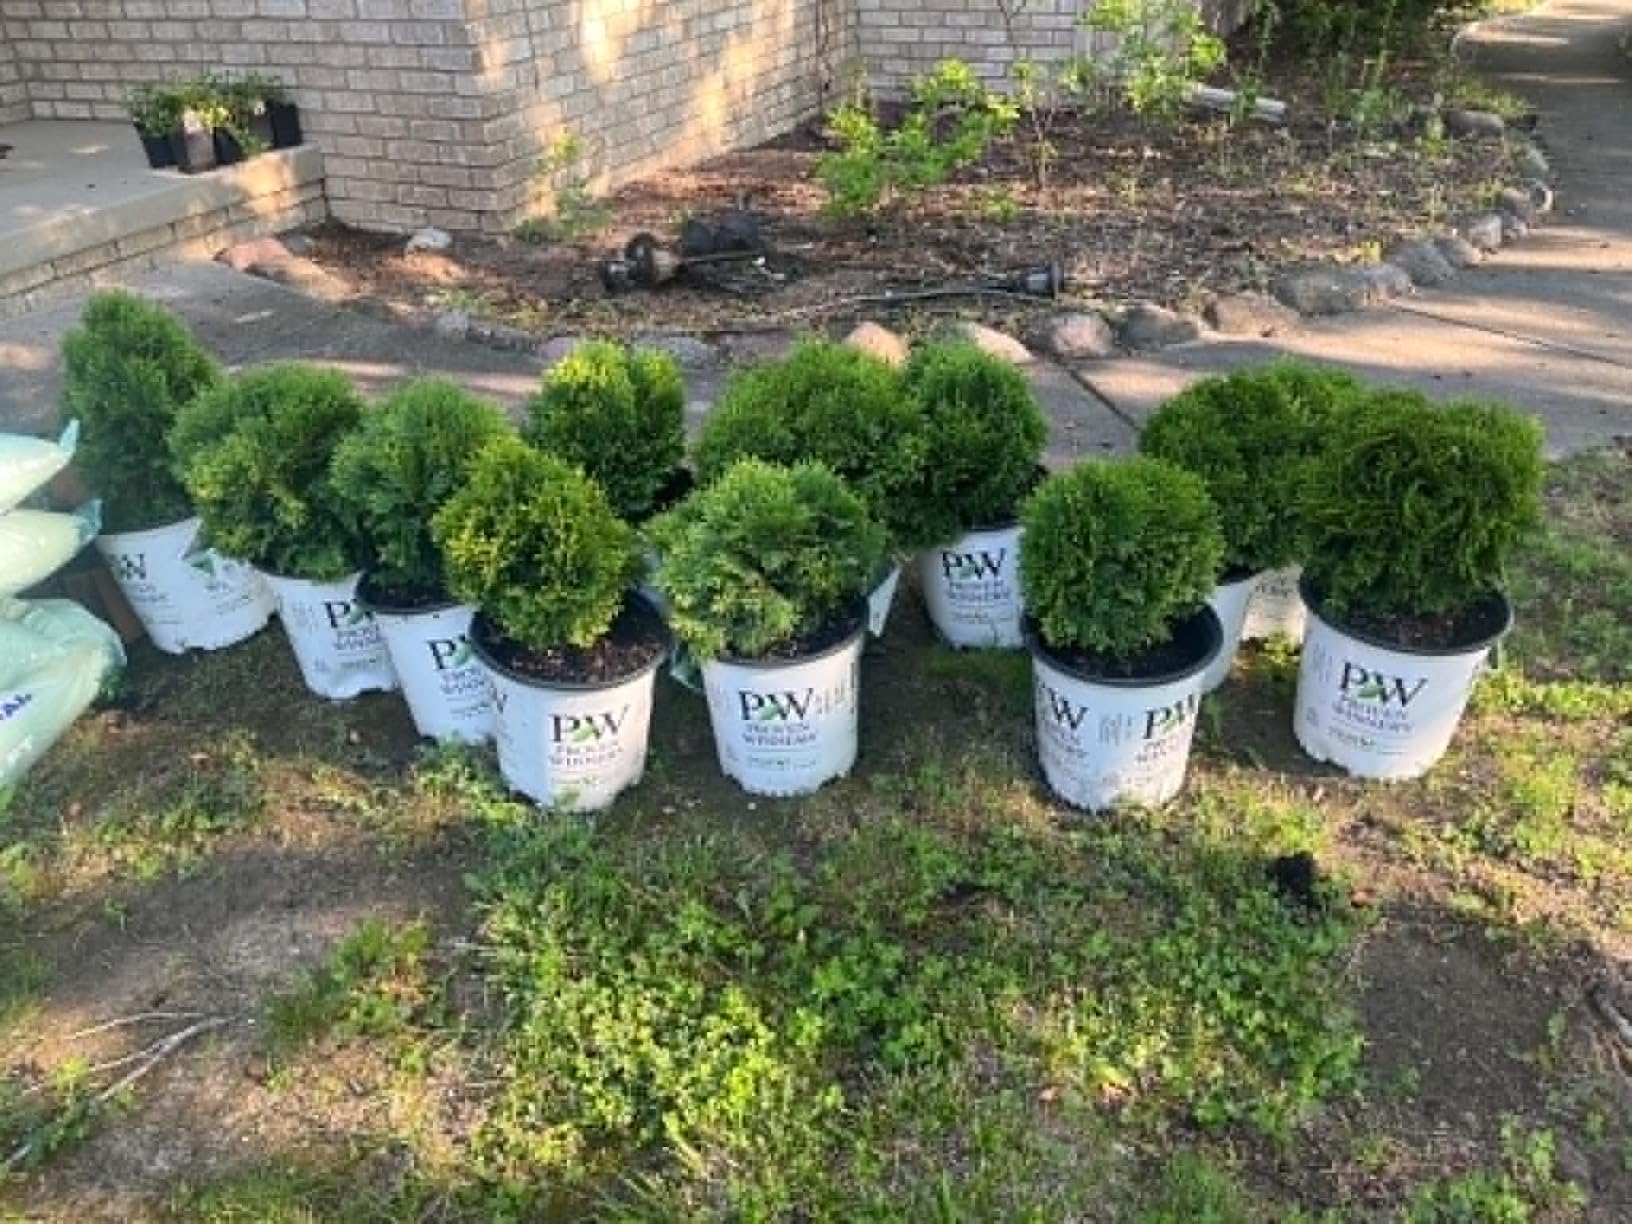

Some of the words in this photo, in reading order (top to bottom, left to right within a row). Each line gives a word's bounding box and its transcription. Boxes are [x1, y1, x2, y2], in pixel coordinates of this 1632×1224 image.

[738, 688, 815, 721] PW
[1340, 661, 1428, 707] PW
[550, 702, 632, 743] PW
